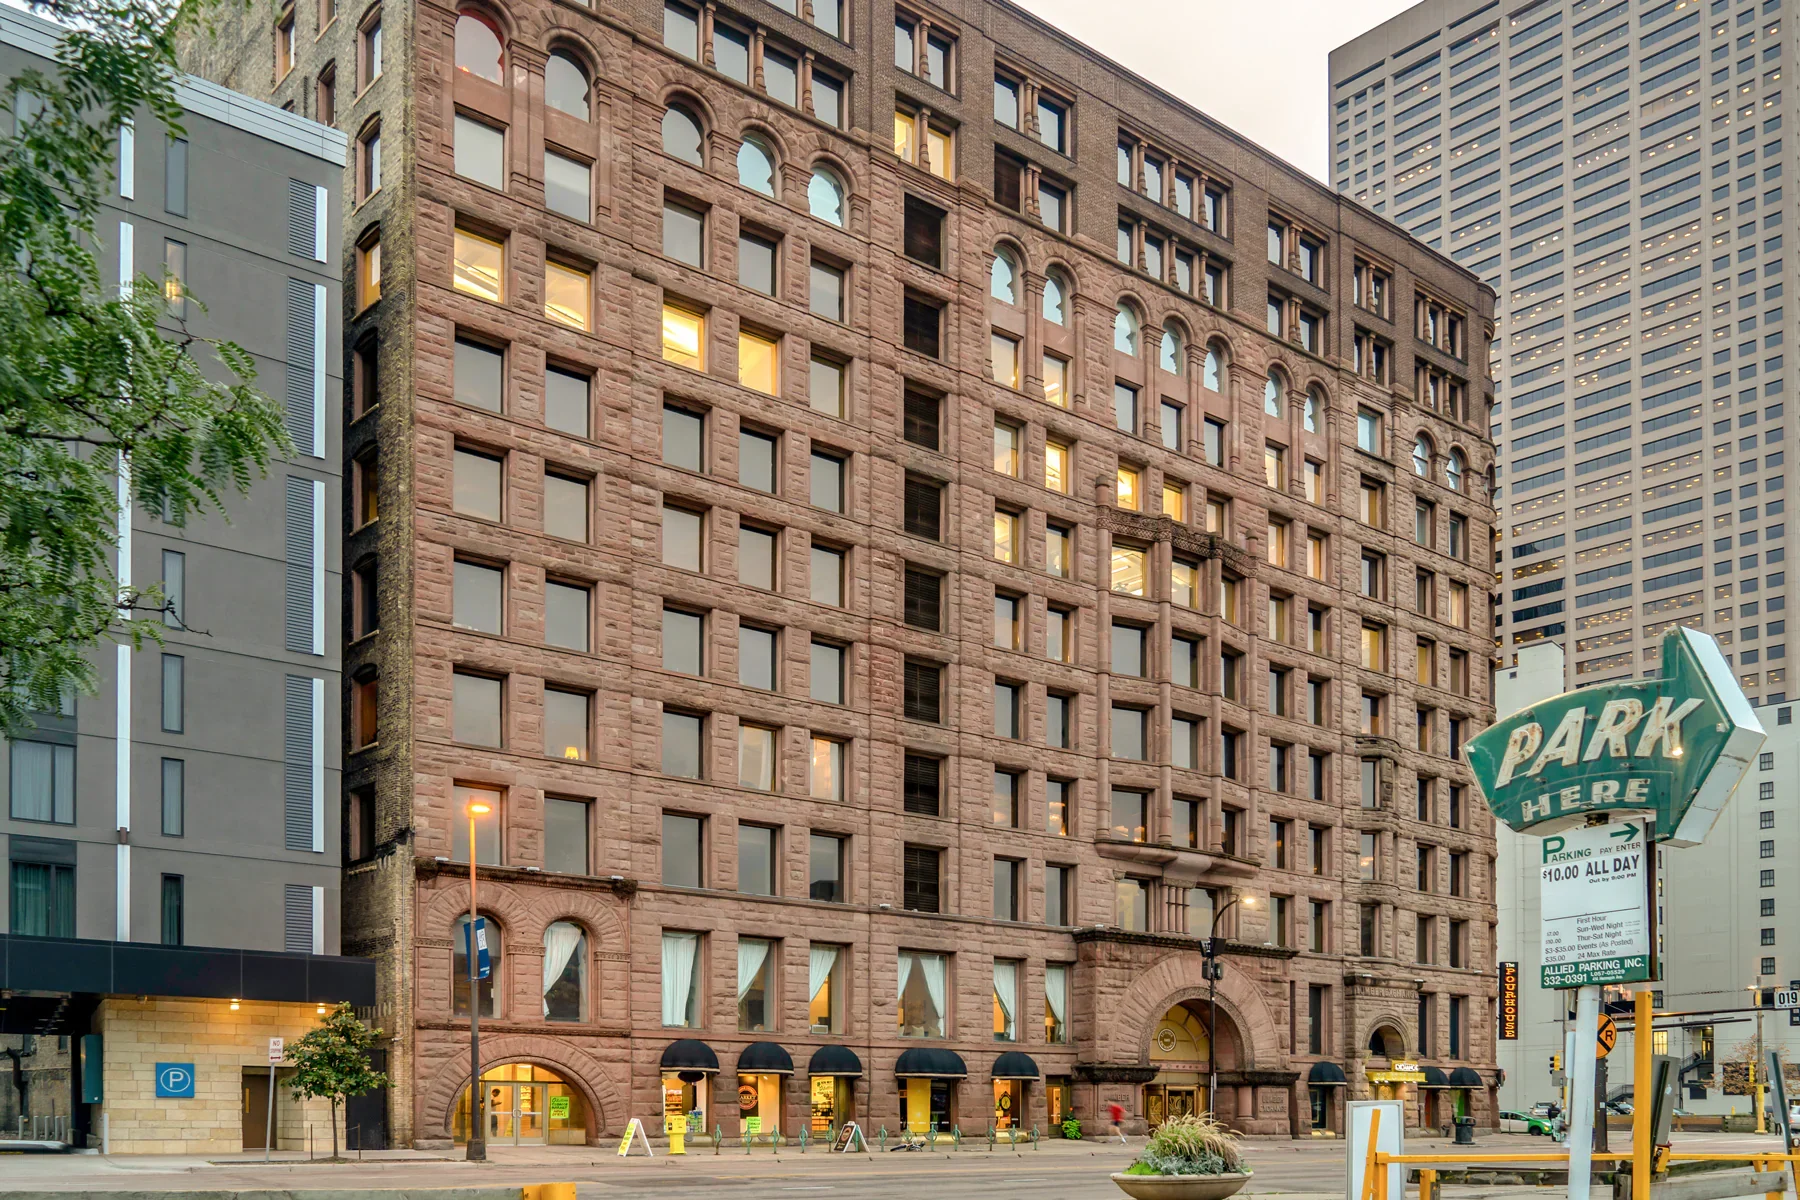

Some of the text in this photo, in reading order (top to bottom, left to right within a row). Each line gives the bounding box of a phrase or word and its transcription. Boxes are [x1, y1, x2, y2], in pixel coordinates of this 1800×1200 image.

[1495, 696, 1704, 789] PARK
[1521, 778, 1650, 822] HERE
[1543, 836, 1640, 864] PARKING PAY ENTER
[1543, 855, 1640, 882] $10.00 ALL DAY
[1576, 916, 1590, 924] First
[1576, 924, 1605, 933] Sun-Wed
[1606, 921, 1623, 929] Night
[1577, 932, 1603, 941] Thur-Sat
[1605, 930, 1622, 939] Night
[1545, 945, 1575, 954] $3-$35.00
[1577, 941, 1597, 950] Events
[1610, 938, 1633, 946] Posted)
[1544, 957, 1645, 975] ALLIED PARKING INC.
[1545, 955, 1565, 963] $35.00
[1544, 974, 1587, 986] 332-0391
[1505, 968, 1516, 1037] POURHOUSE
[1778, 991, 1797, 1004] 019
[1605, 1030, 1613, 1041] R
